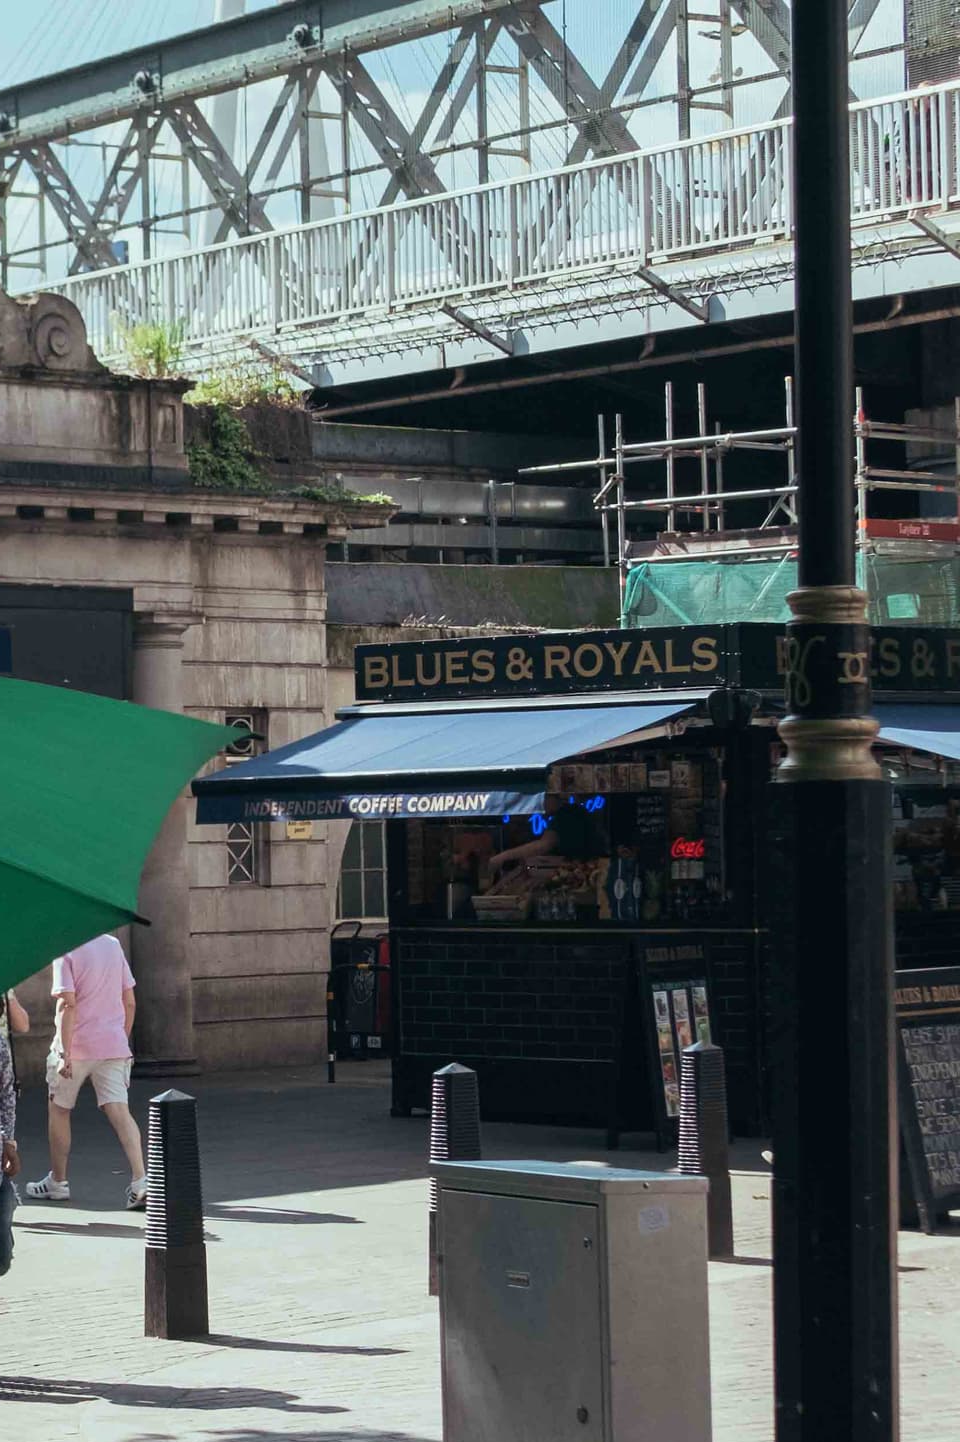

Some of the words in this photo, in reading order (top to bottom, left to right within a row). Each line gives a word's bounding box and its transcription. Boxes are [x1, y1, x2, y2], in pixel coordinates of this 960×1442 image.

[363, 648, 496, 689] BLUES
[505, 646, 534, 681] &
[543, 636, 720, 680] ROYALS
[242, 799, 345, 818] INDEPENDENT
[348, 796, 404, 815] COFFEE
[406, 792, 490, 813] COMPANY
